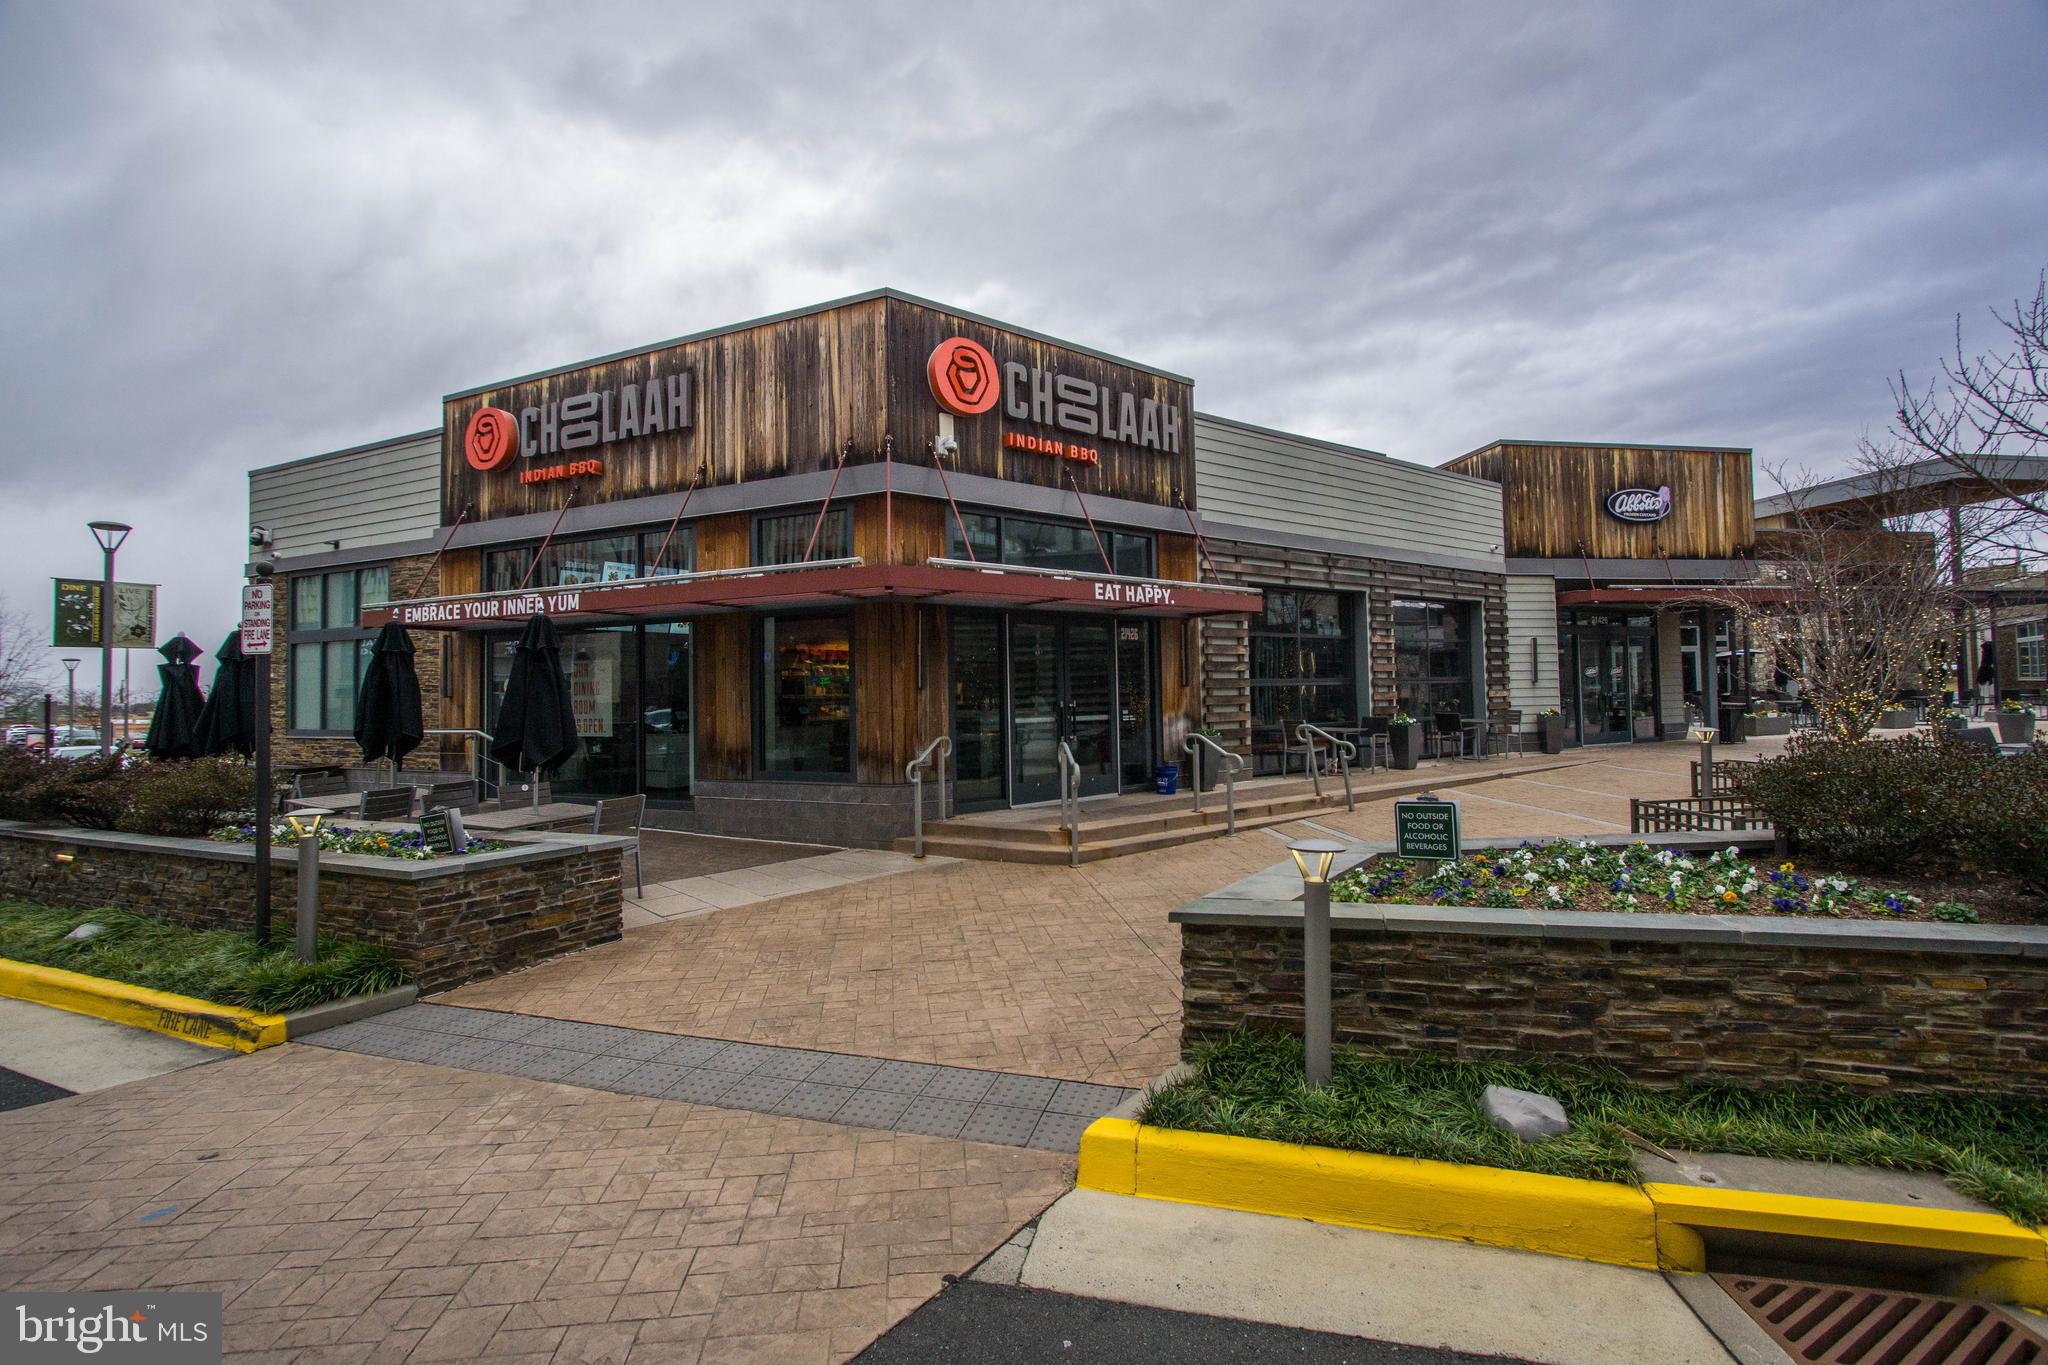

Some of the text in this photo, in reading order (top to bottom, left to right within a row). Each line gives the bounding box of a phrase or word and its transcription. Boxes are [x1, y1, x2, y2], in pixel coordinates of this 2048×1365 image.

[1003, 361, 1180, 454] CHOOLAAH
[520, 372, 690, 458] CHOOLAAH
[1008, 432, 1099, 465] INDIAN BBQ
[520, 459, 601, 484] INDIAN BBQ
[61, 583, 87, 592] DINE
[120, 587, 142, 595] LIVE
[251, 590, 263, 599] NO
[1094, 583, 1175, 605] EAT HAPPY.
[244, 600, 271, 610] PARKING
[405, 593, 580, 623] EMBRACE YOUR INNER YUM
[244, 618, 271, 628] STANDING
[244, 629, 270, 640] FIRE LANE
[1401, 812, 1449, 820] NO OUTSIDE
[1407, 822, 1444, 831] FOOD OR
[1403, 832, 1449, 841] ALCOHOLIC
[1406, 842, 1448, 851] BEVERAGES
[157, 1009, 212, 1039] FIRE LANE
